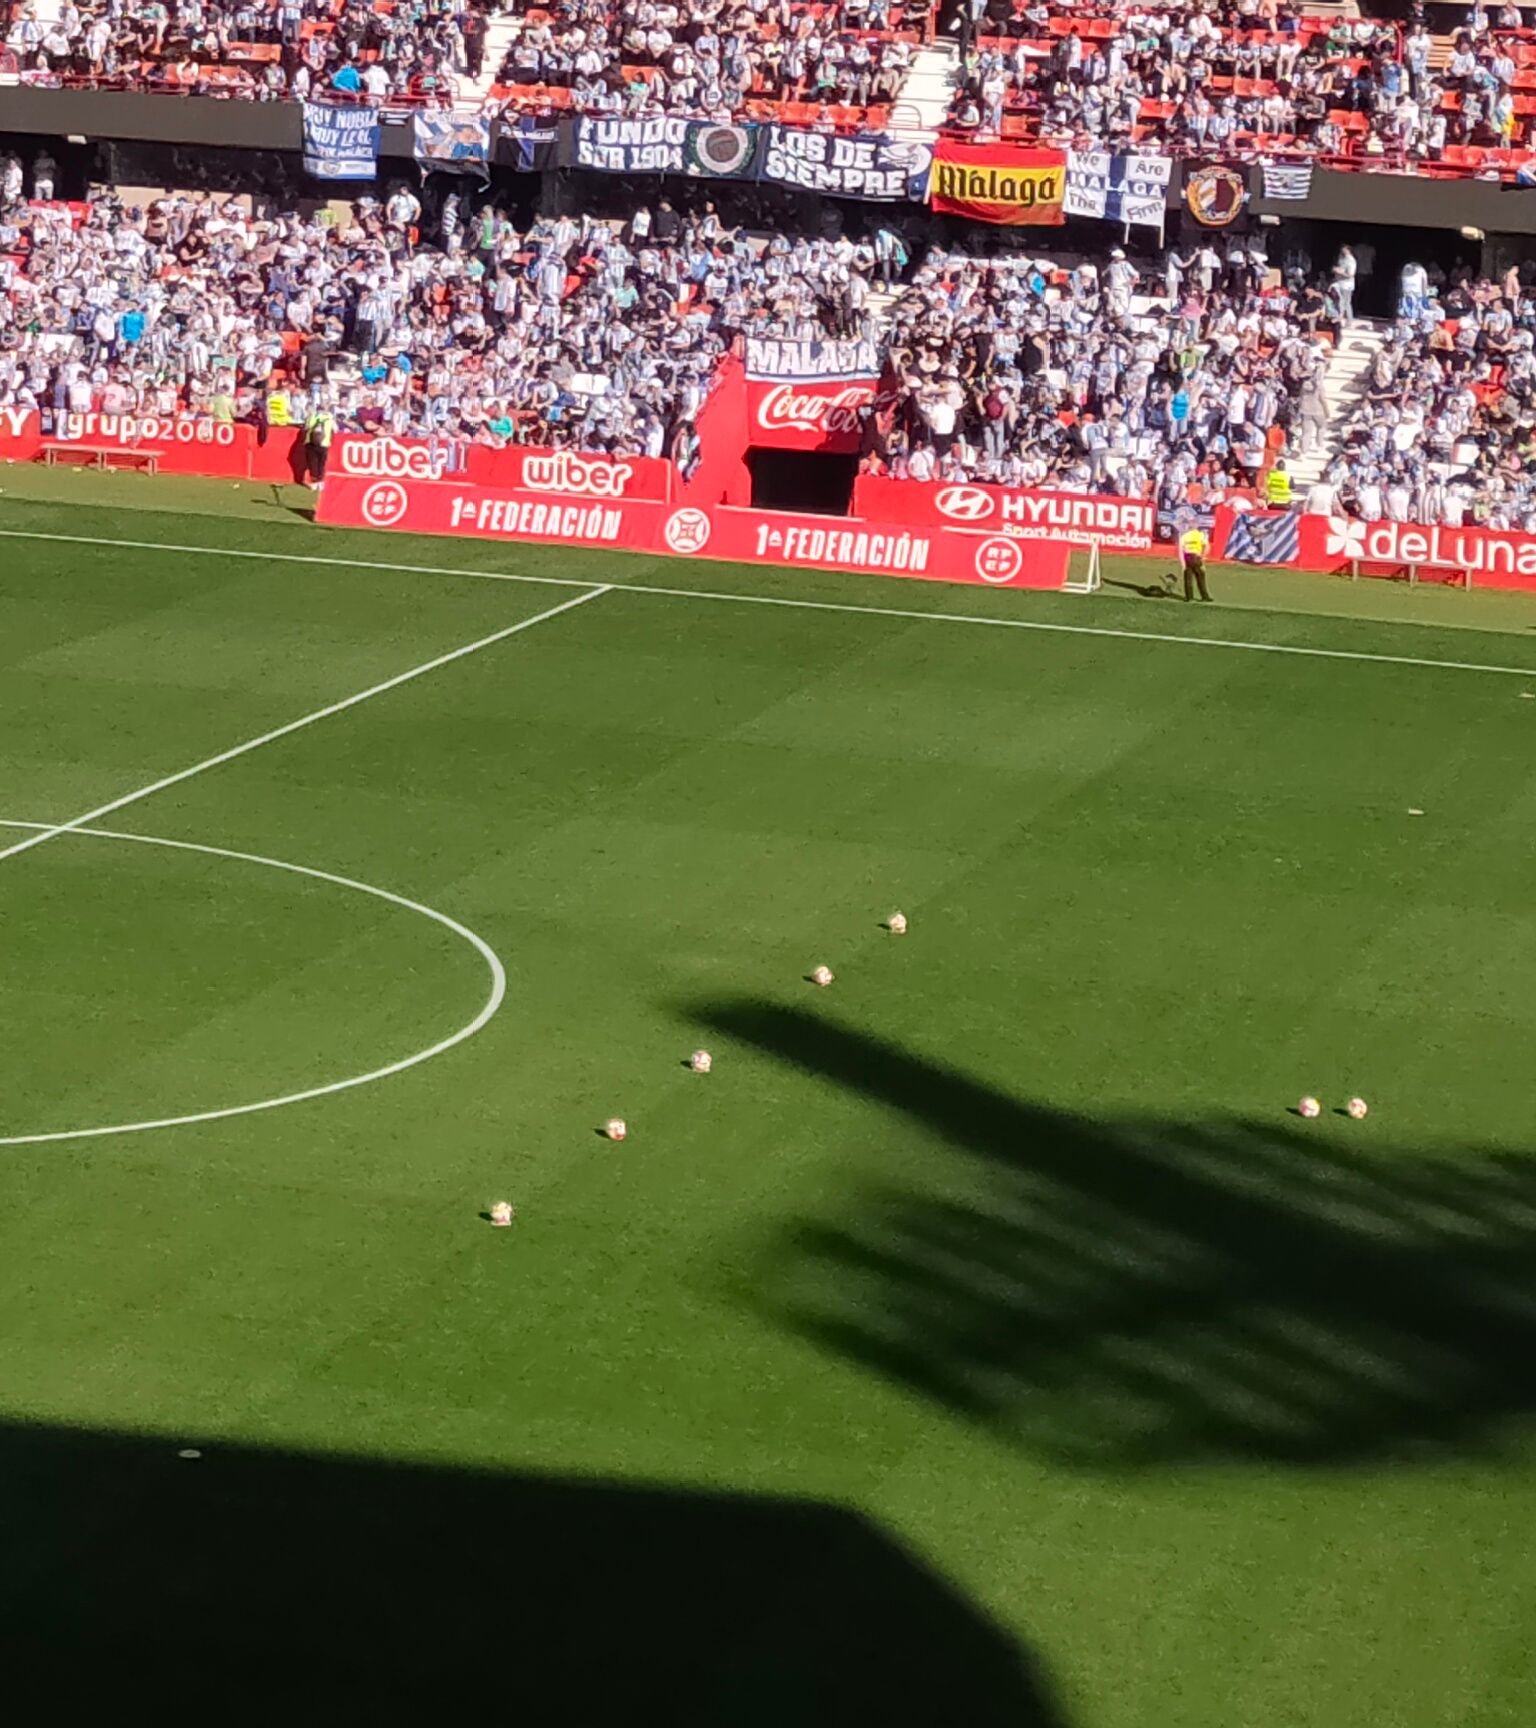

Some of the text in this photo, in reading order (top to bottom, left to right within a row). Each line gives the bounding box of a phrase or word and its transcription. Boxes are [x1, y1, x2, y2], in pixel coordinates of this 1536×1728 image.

[770, 126, 877, 170] LOS DE
[1135, 160, 1165, 177] Are
[765, 150, 907, 196] SIEMPRE
[522, 450, 634, 497] wiber
[1002, 495, 1153, 532] HYUNDAI
